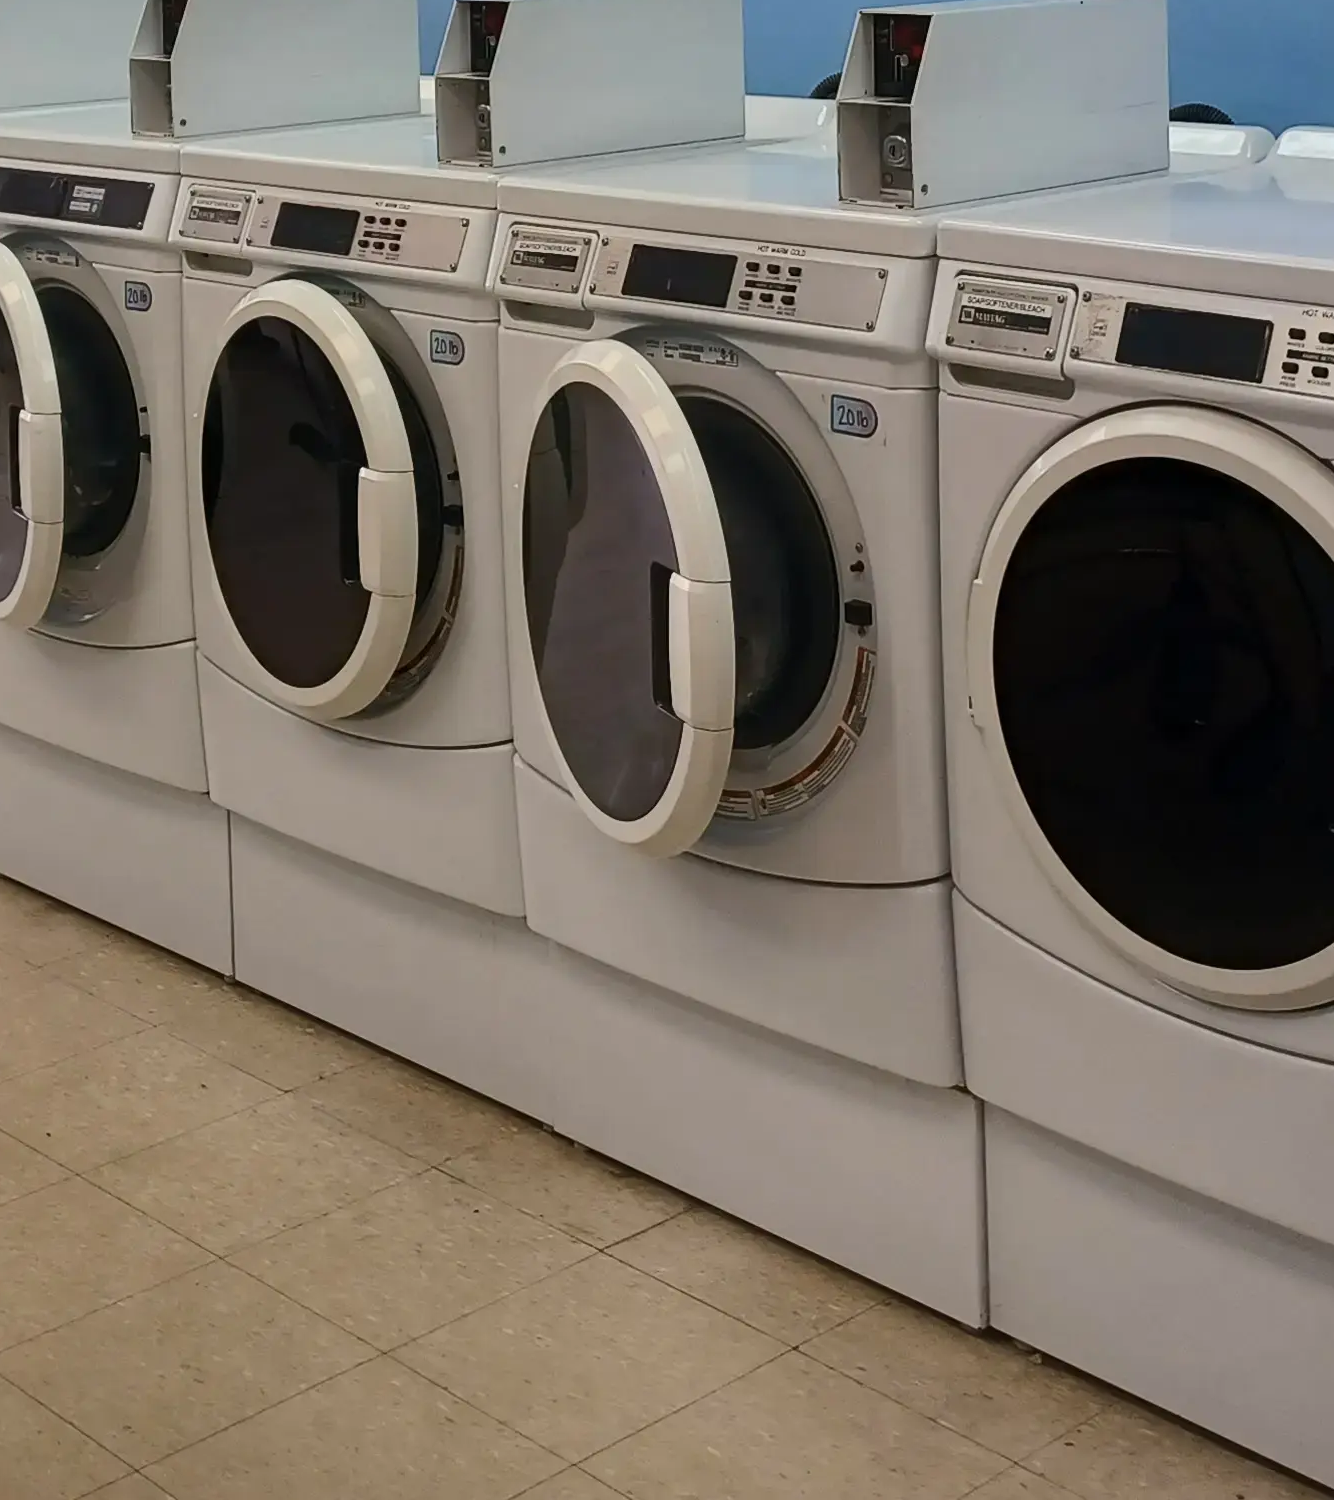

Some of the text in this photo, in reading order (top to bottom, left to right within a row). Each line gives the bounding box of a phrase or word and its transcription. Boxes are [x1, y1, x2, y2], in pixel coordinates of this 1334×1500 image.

[127, 287, 139, 304] 20
[1301, 308, 1319, 317] HOT
[434, 336, 459, 356] 20 lb
[837, 404, 869, 428] 20 lb
